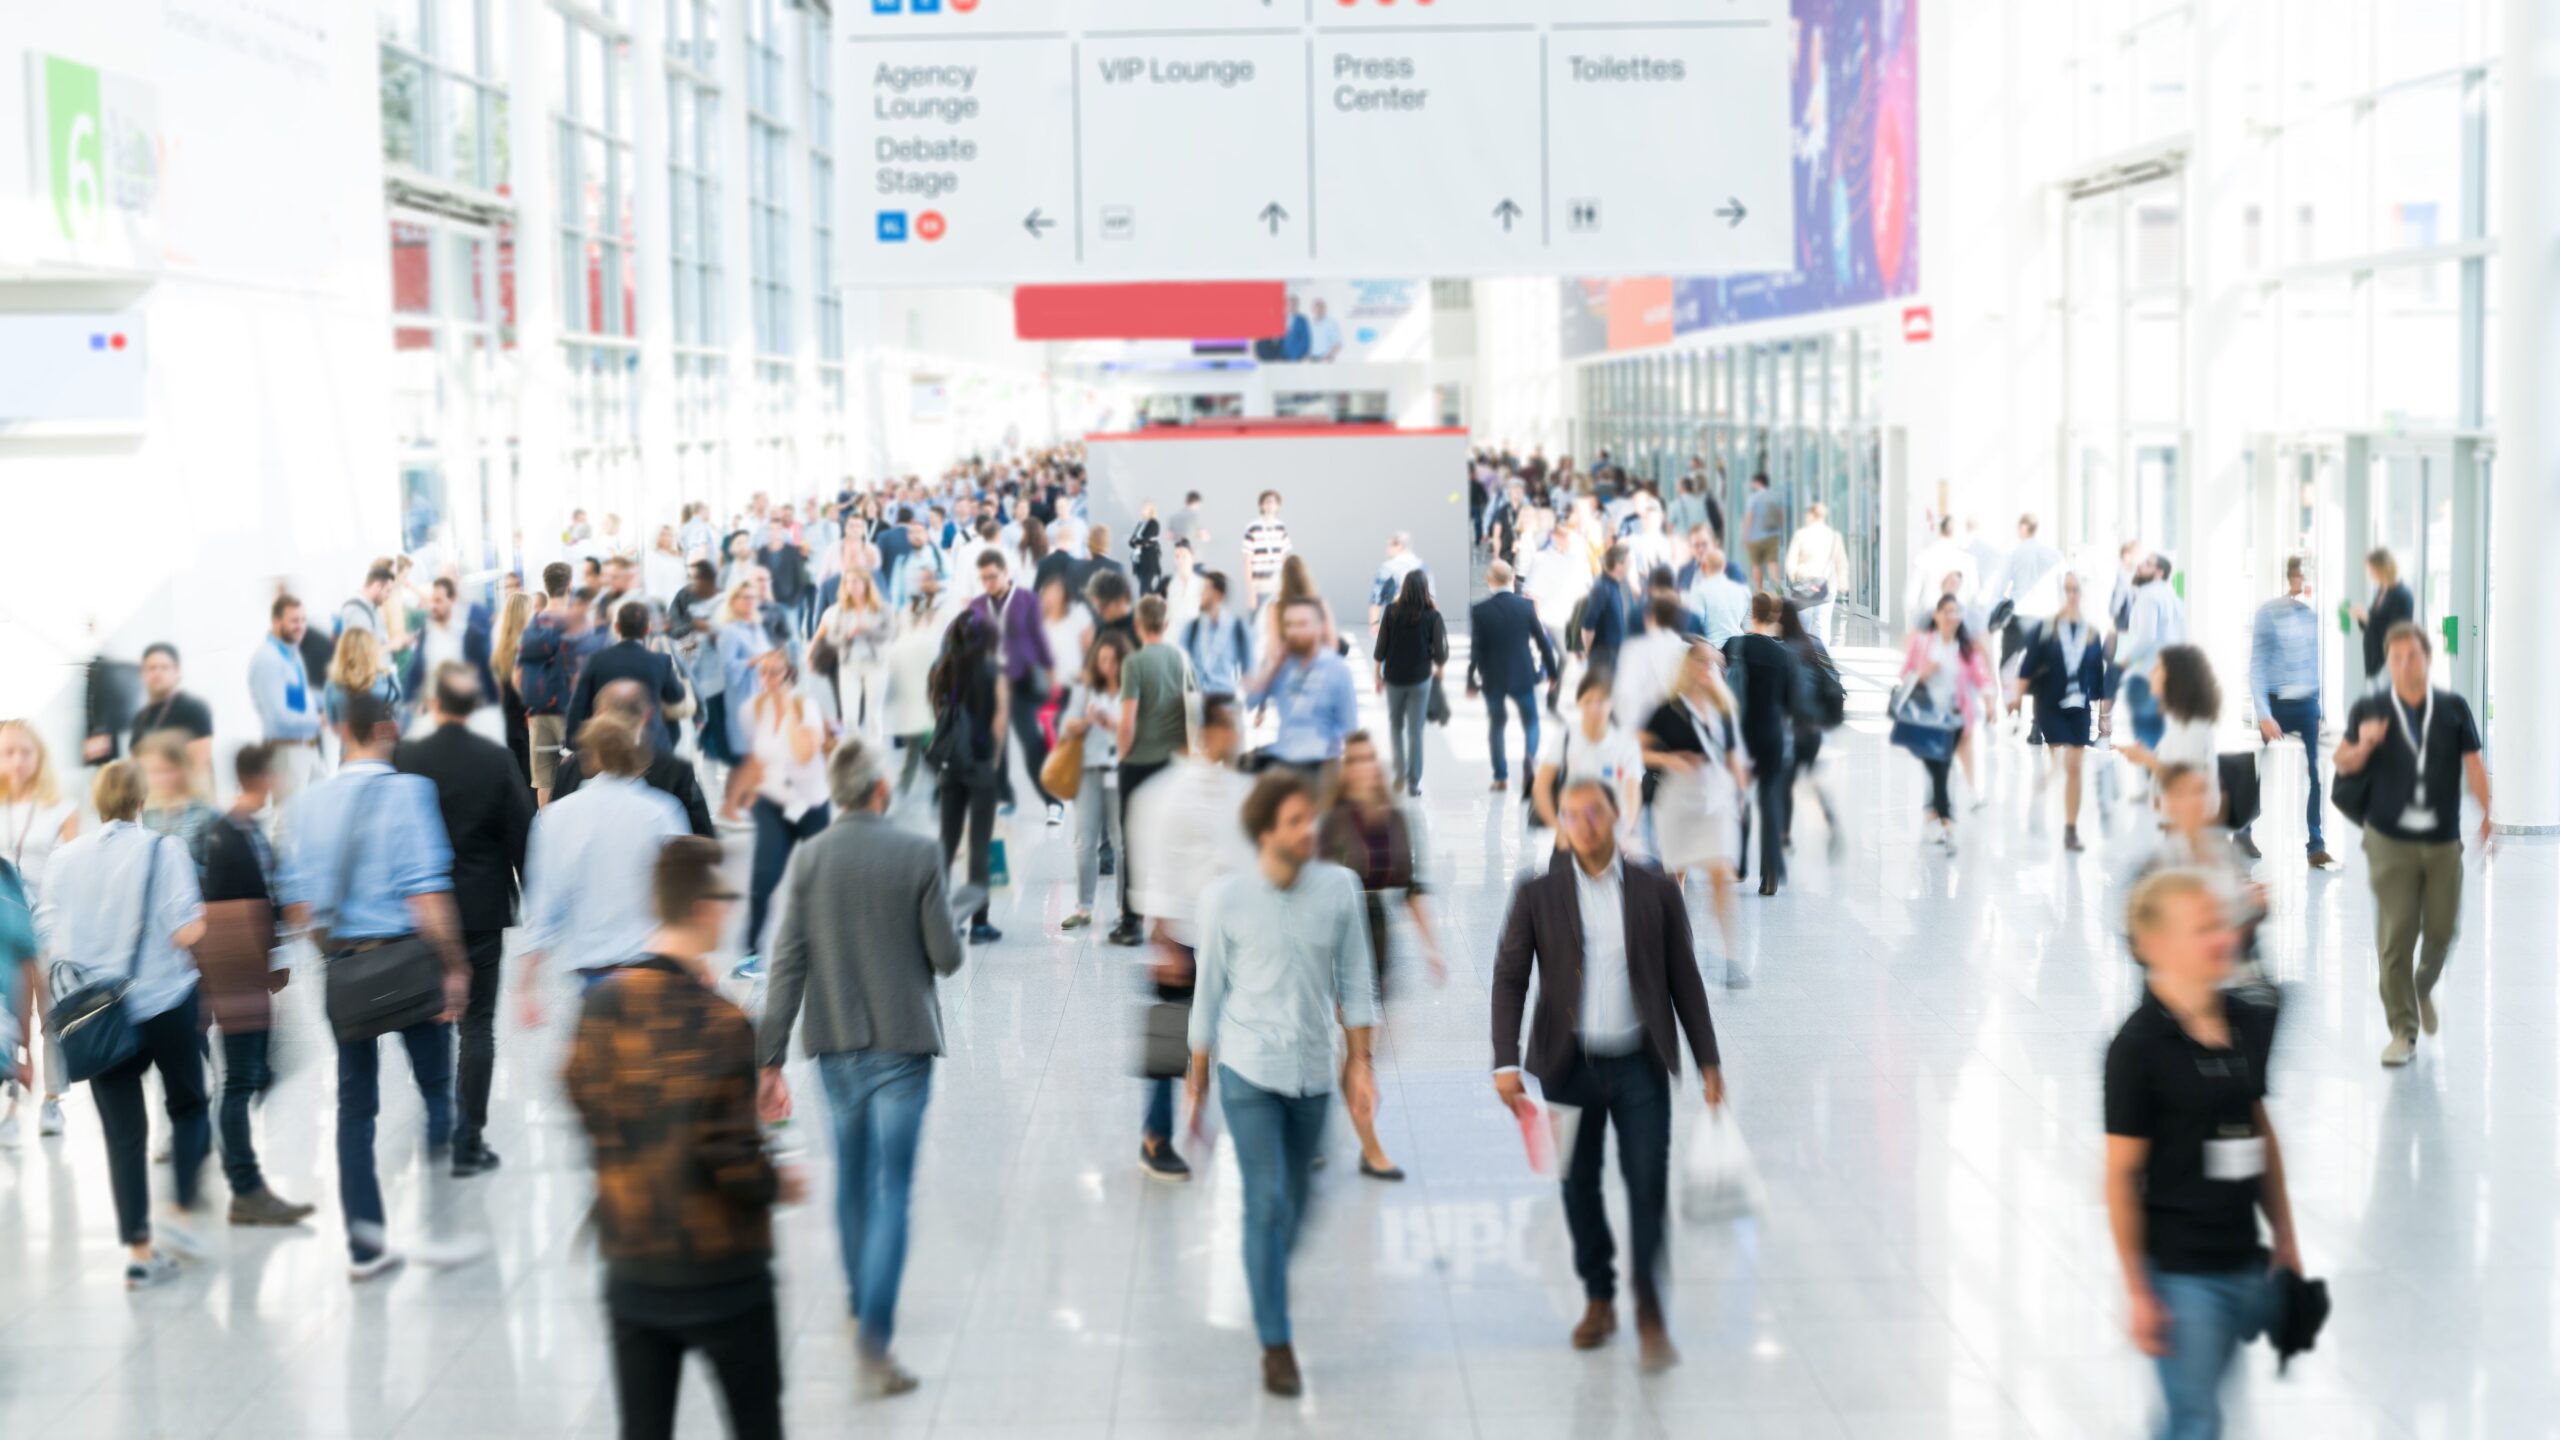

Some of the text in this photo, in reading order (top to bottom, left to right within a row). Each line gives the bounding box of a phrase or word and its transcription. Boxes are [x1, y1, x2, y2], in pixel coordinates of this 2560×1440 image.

[874, 62, 977, 93] Agency
[1099, 58, 1255, 88] VIP Lounge
[1334, 53, 1414, 79] Press
[1570, 56, 1686, 82] Toilettes
[875, 96, 979, 123] Lounge
[1334, 85, 1427, 112] Center
[875, 136, 977, 162] Debate
[876, 168, 958, 198] Stage
